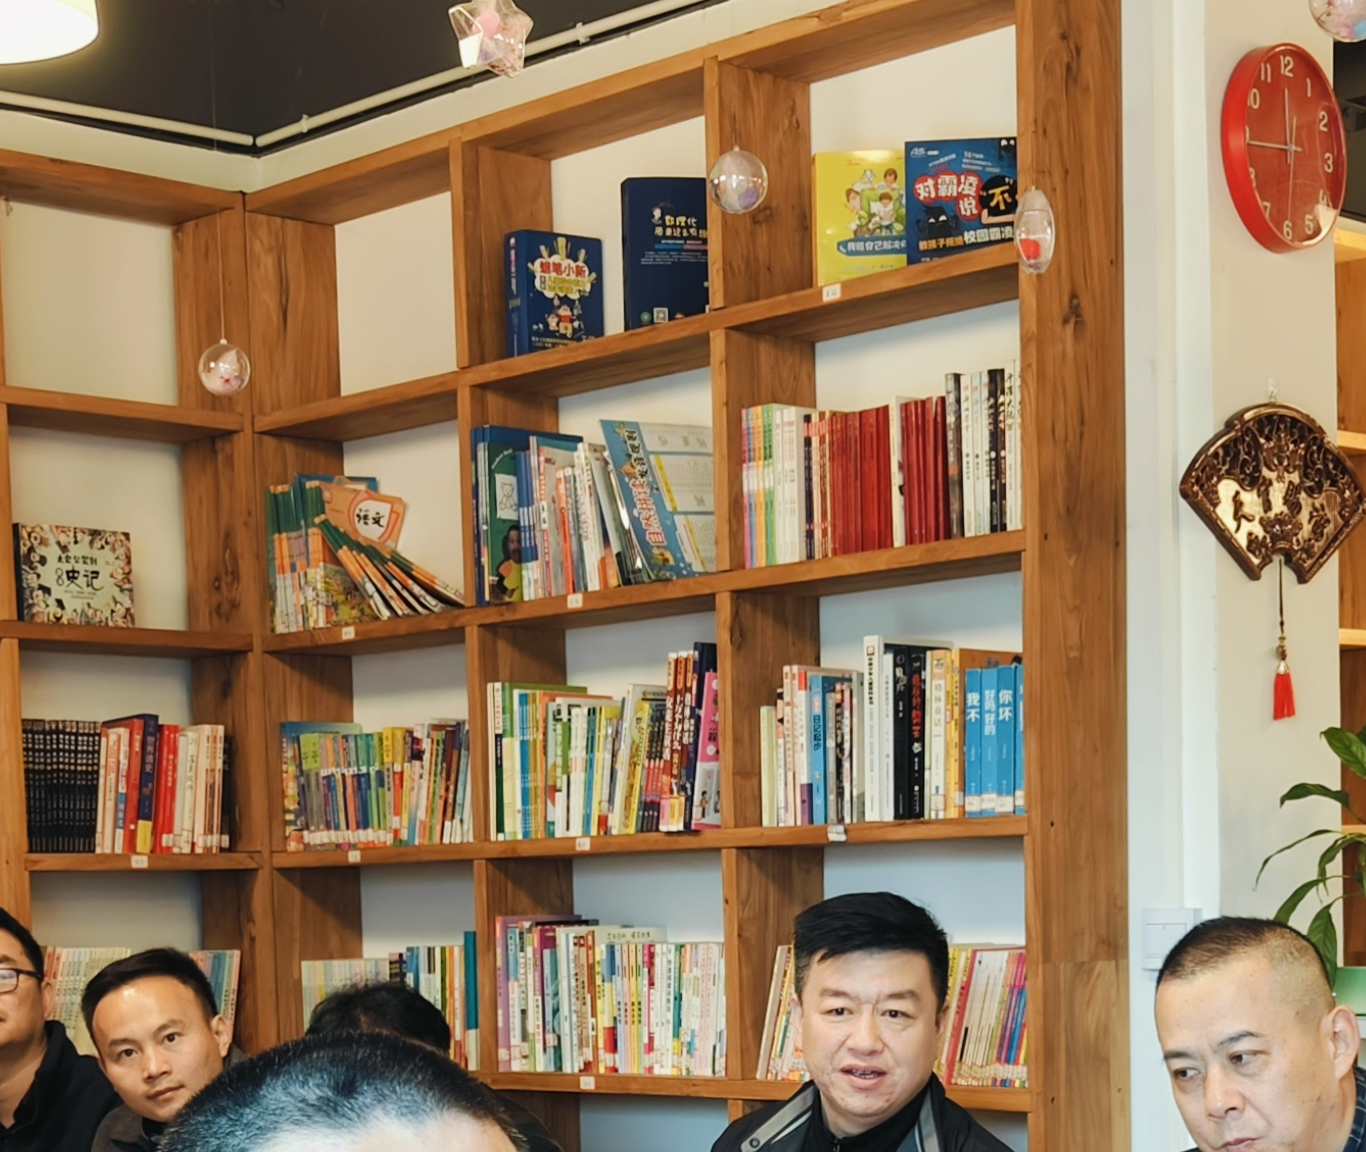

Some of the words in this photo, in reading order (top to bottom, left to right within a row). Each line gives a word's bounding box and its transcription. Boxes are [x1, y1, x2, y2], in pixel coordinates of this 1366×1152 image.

[1260, 62, 1271, 83] 11
[1280, 55, 1293, 77] 12
[1306, 77, 1312, 97] 1
[1319, 111, 1329, 132] 2
[1324, 152, 1334, 173] 3
[958, 197, 979, 217] 说
[989, 185, 1012, 211] 不
[1263, 201, 1271, 219] 7
[1283, 220, 1293, 240] 6
[1304, 214, 1314, 235] 5
[355, 508, 386, 529] 语文
[65, 564, 105, 592] 史记
[965, 691, 981, 723] 我不
[998, 689, 1014, 722] 你坏
